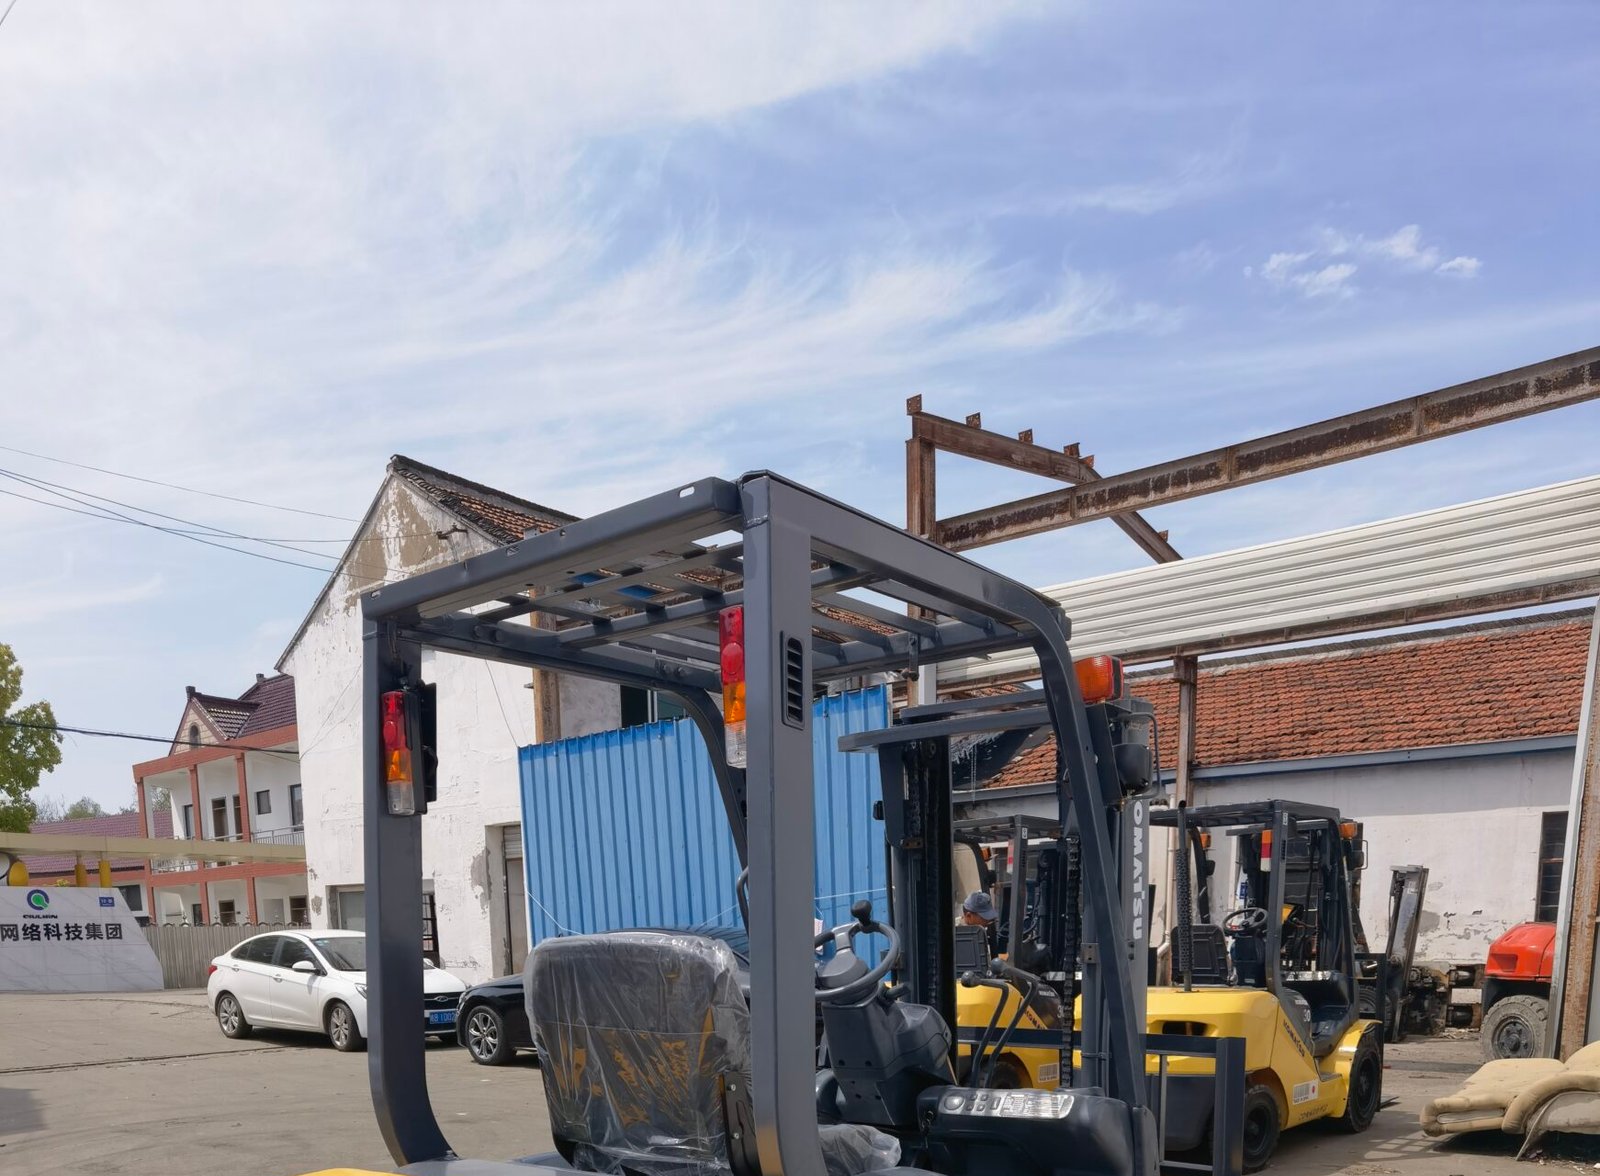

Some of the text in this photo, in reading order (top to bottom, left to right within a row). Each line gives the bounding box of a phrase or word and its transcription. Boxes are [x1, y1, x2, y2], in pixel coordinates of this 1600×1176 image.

[1132, 798, 1145, 940] OMATSU
[0, 922, 124, 942] 网络科技集团
